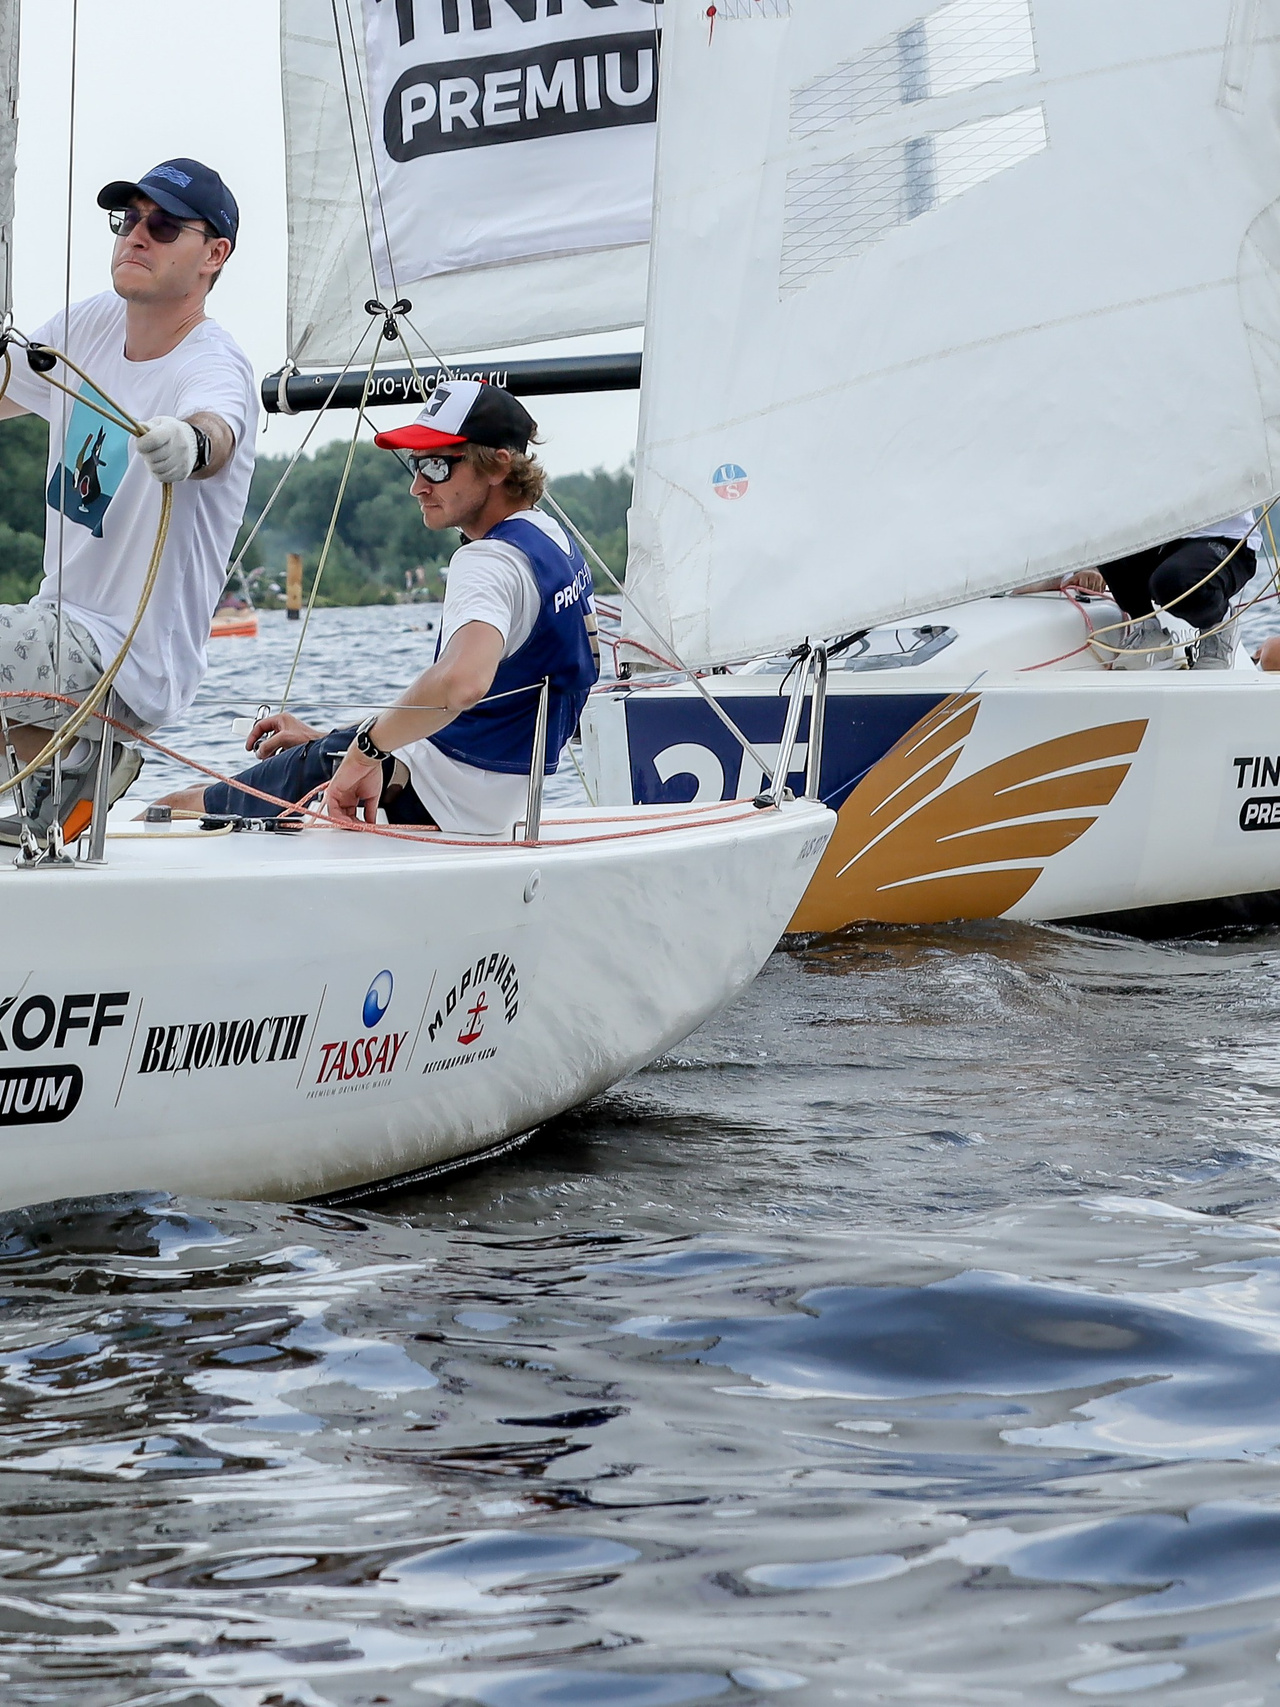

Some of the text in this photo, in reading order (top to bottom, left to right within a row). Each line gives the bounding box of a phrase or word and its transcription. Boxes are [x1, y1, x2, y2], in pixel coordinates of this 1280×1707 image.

[427, 952, 520, 1043] МОРПРИБОР
[137, 1014, 308, 1078] ВЕДОМОСТИ
[315, 1030, 410, 1084] TASSAY
